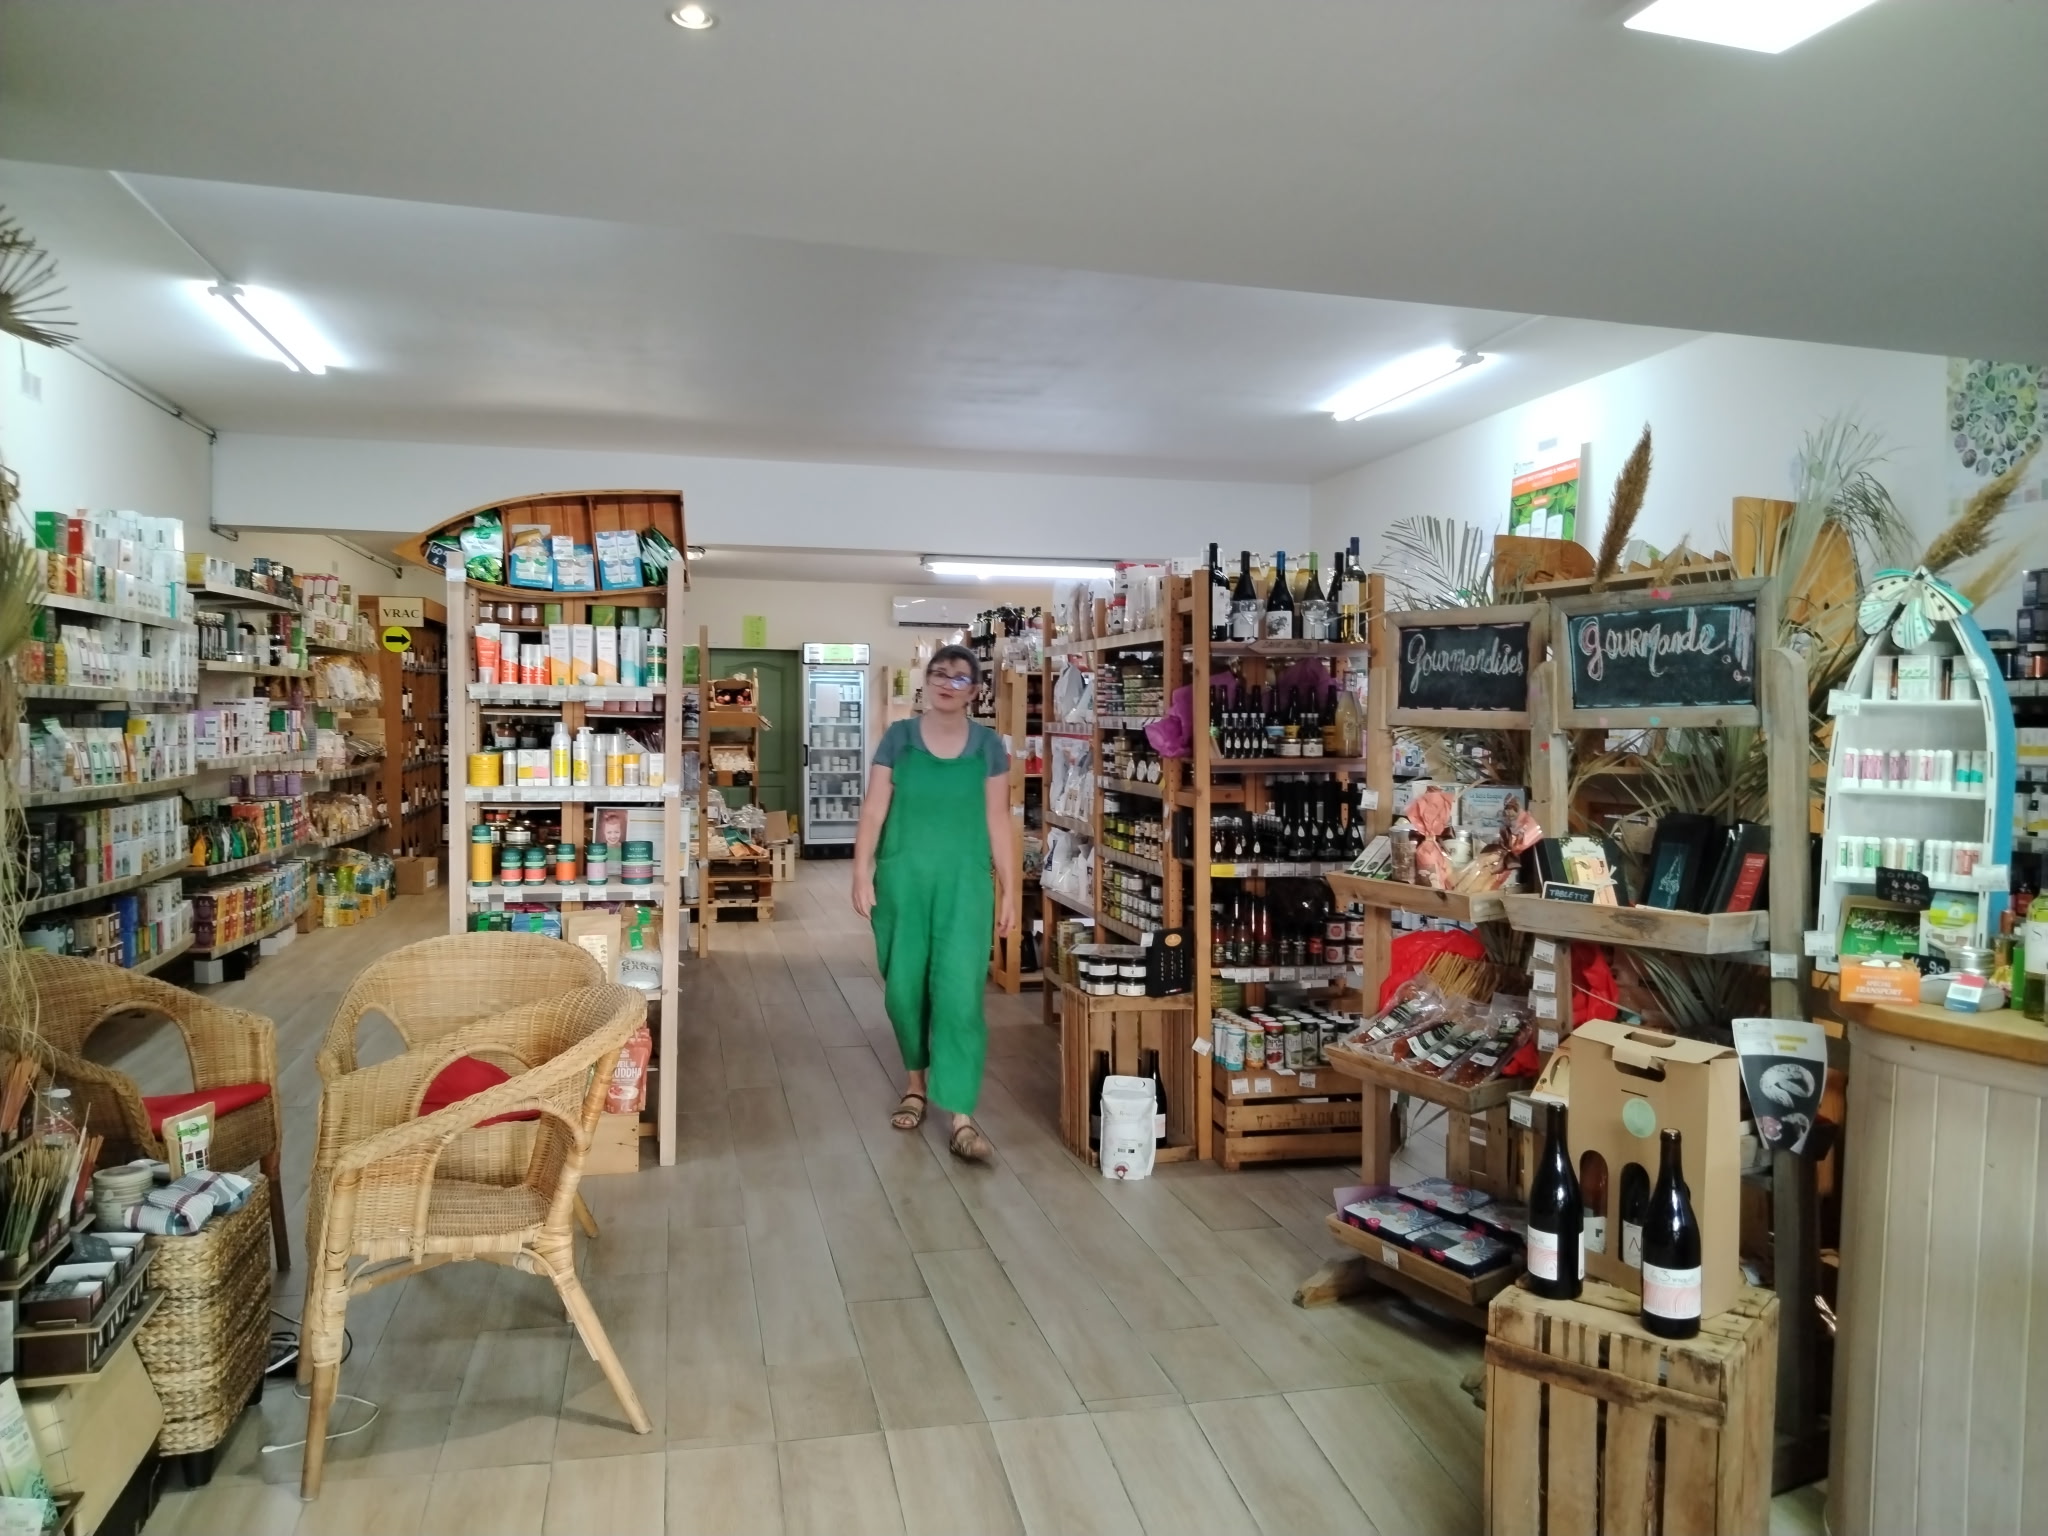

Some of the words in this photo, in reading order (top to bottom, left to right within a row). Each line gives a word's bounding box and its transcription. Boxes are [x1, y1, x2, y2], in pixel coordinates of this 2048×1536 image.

[383, 608, 420, 619] VRAC
[1407, 633, 1524, 694] Gourmandises
[1549, 888, 1590, 902] TABLETTE
[1855, 986, 1903, 996] TRANSPORT
